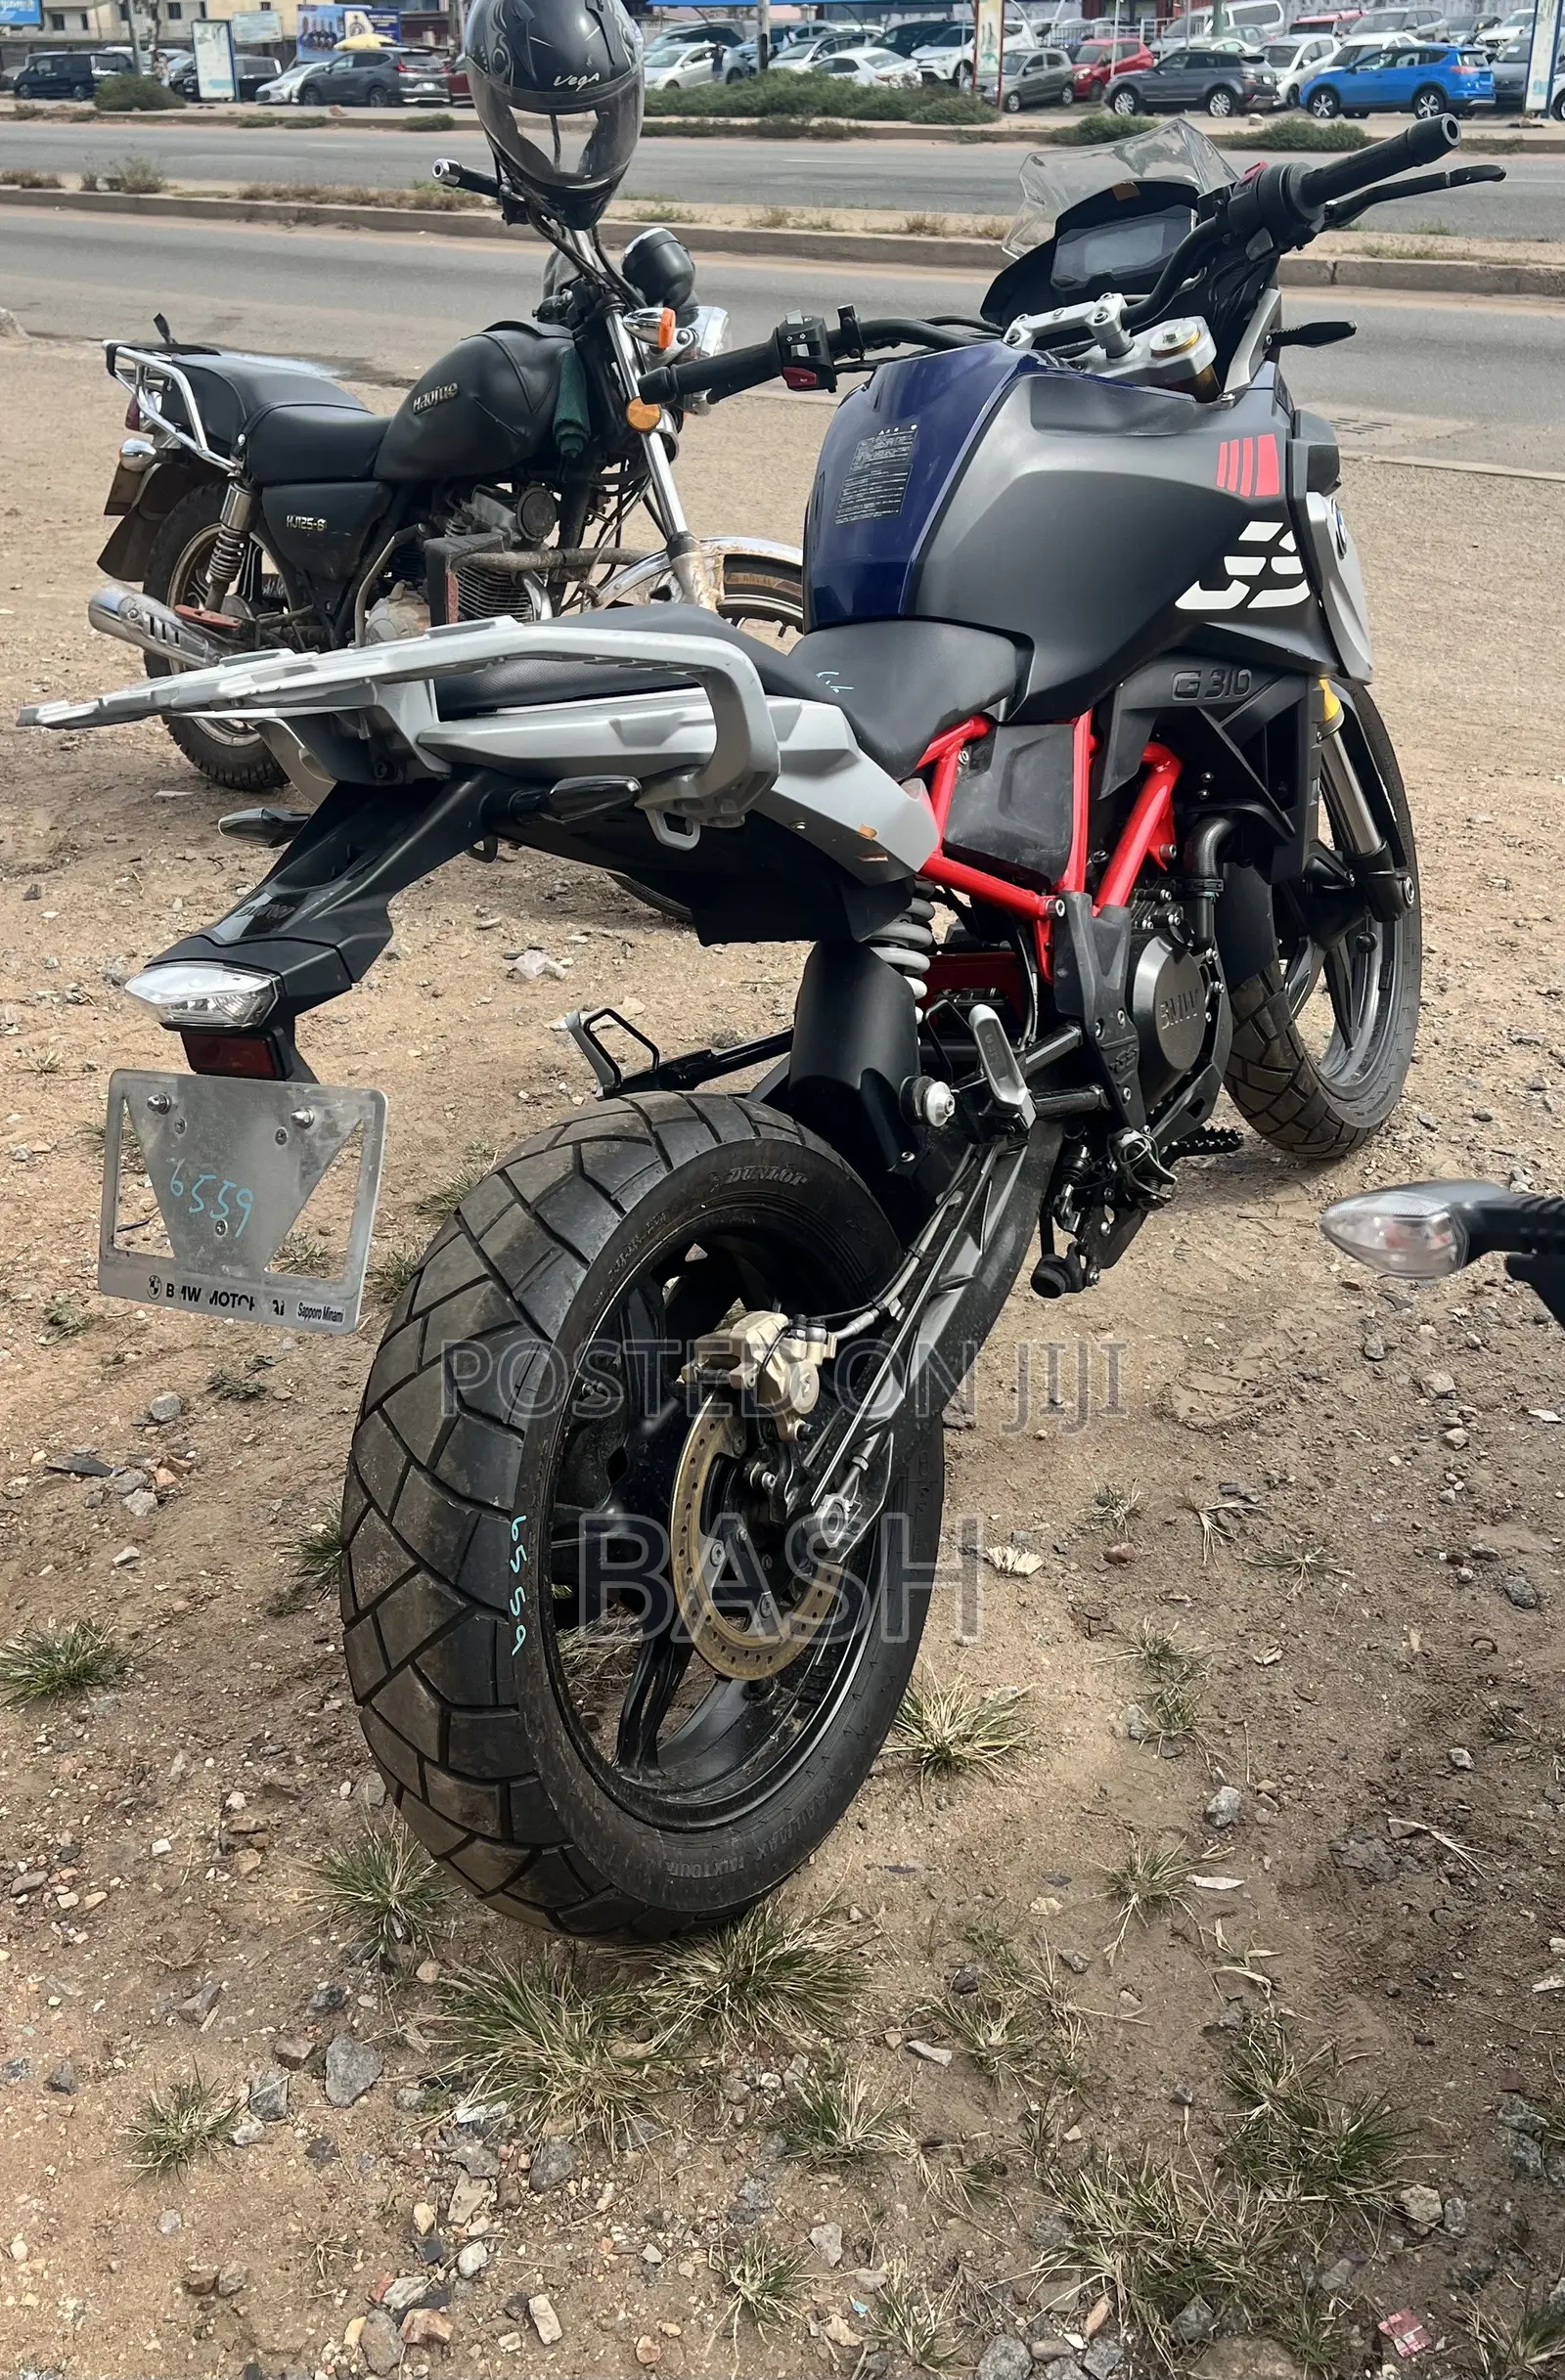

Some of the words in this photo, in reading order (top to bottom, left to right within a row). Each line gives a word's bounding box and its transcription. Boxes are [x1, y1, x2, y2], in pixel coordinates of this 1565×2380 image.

[1175, 520, 1312, 610] GS
[1171, 670, 1202, 702] G
[1203, 668, 1253, 701] 310
[728, 1164, 809, 1187] DUNLOP
[169, 1158, 254, 1239] 6559
[297, 1301, 323, 1322] Sapporo
